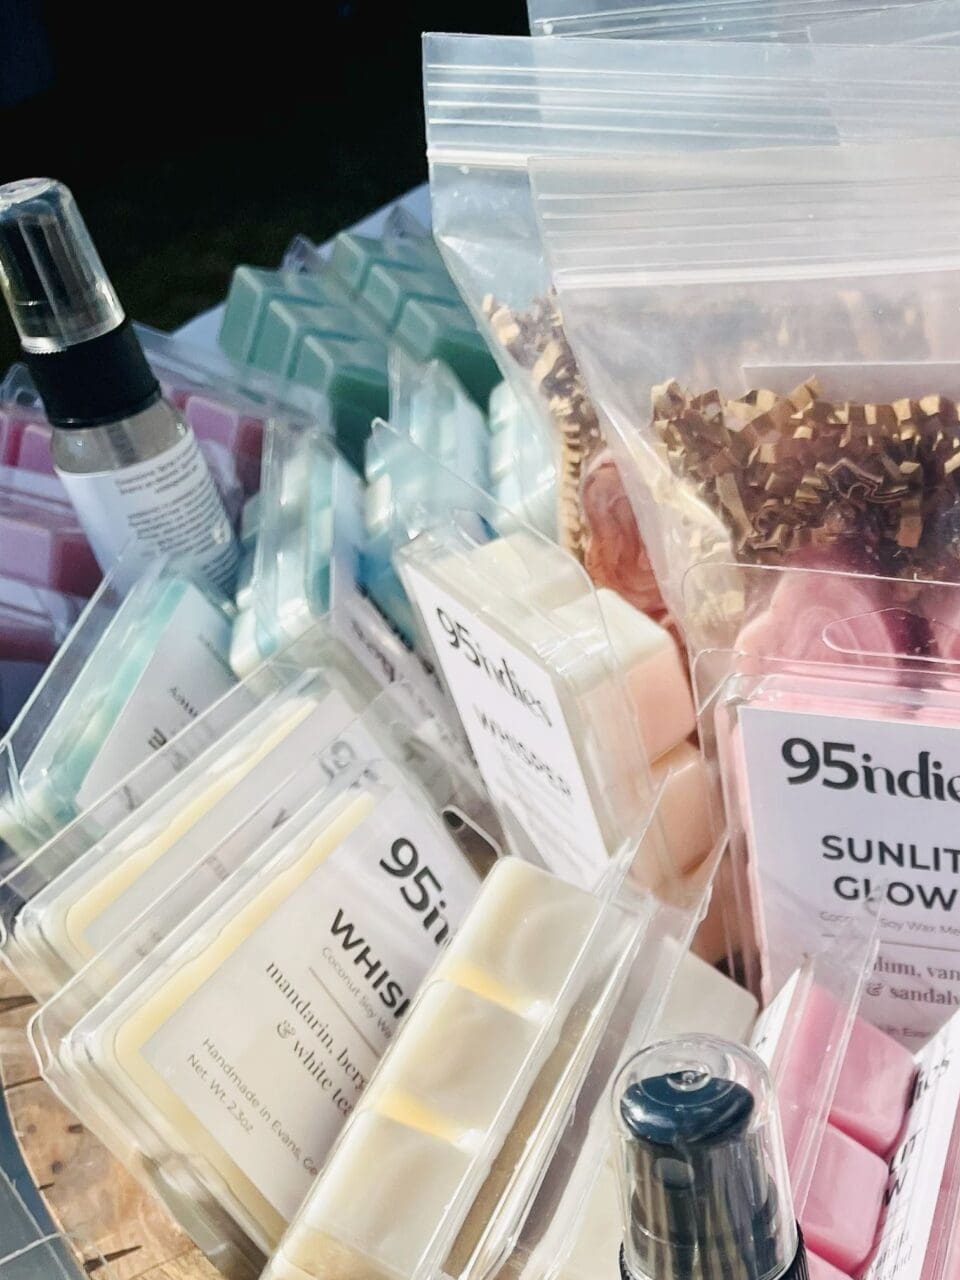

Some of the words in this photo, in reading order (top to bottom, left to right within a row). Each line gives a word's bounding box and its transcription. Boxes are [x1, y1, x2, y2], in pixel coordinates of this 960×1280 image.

[379, 837, 453, 947] 95in
[833, 875, 958, 912] GLOW
[330, 908, 411, 1019] WHIS
[873, 956, 922, 978] lum,
[265, 962, 335, 1054] mandarin,
[202, 1036, 262, 1109] Handmade
[276, 1018, 297, 1039] &
[291, 1040, 334, 1091] white
